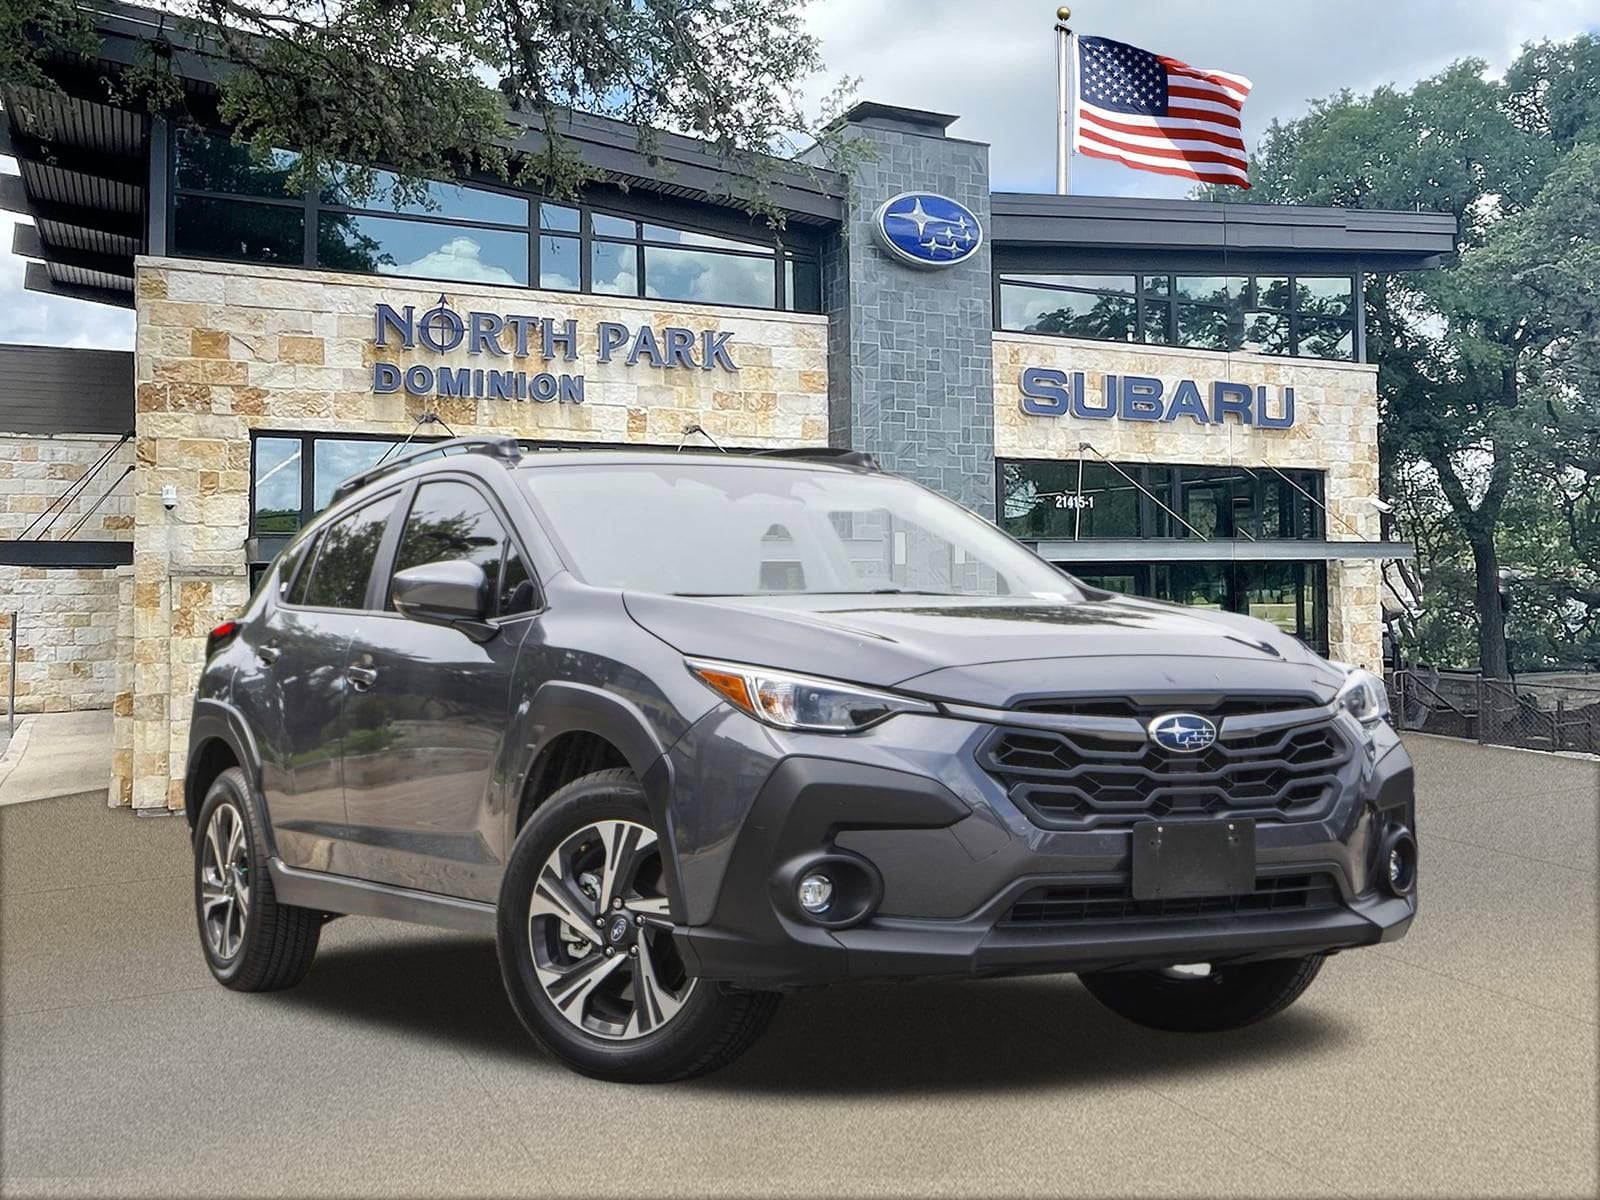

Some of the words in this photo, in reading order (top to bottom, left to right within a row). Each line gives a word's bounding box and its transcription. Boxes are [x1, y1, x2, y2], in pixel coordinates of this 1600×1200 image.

[374, 293, 579, 361] NORTH
[596, 320, 741, 373] PARK
[373, 362, 585, 405] DOMINION
[1020, 367, 1294, 429] SUBARU
